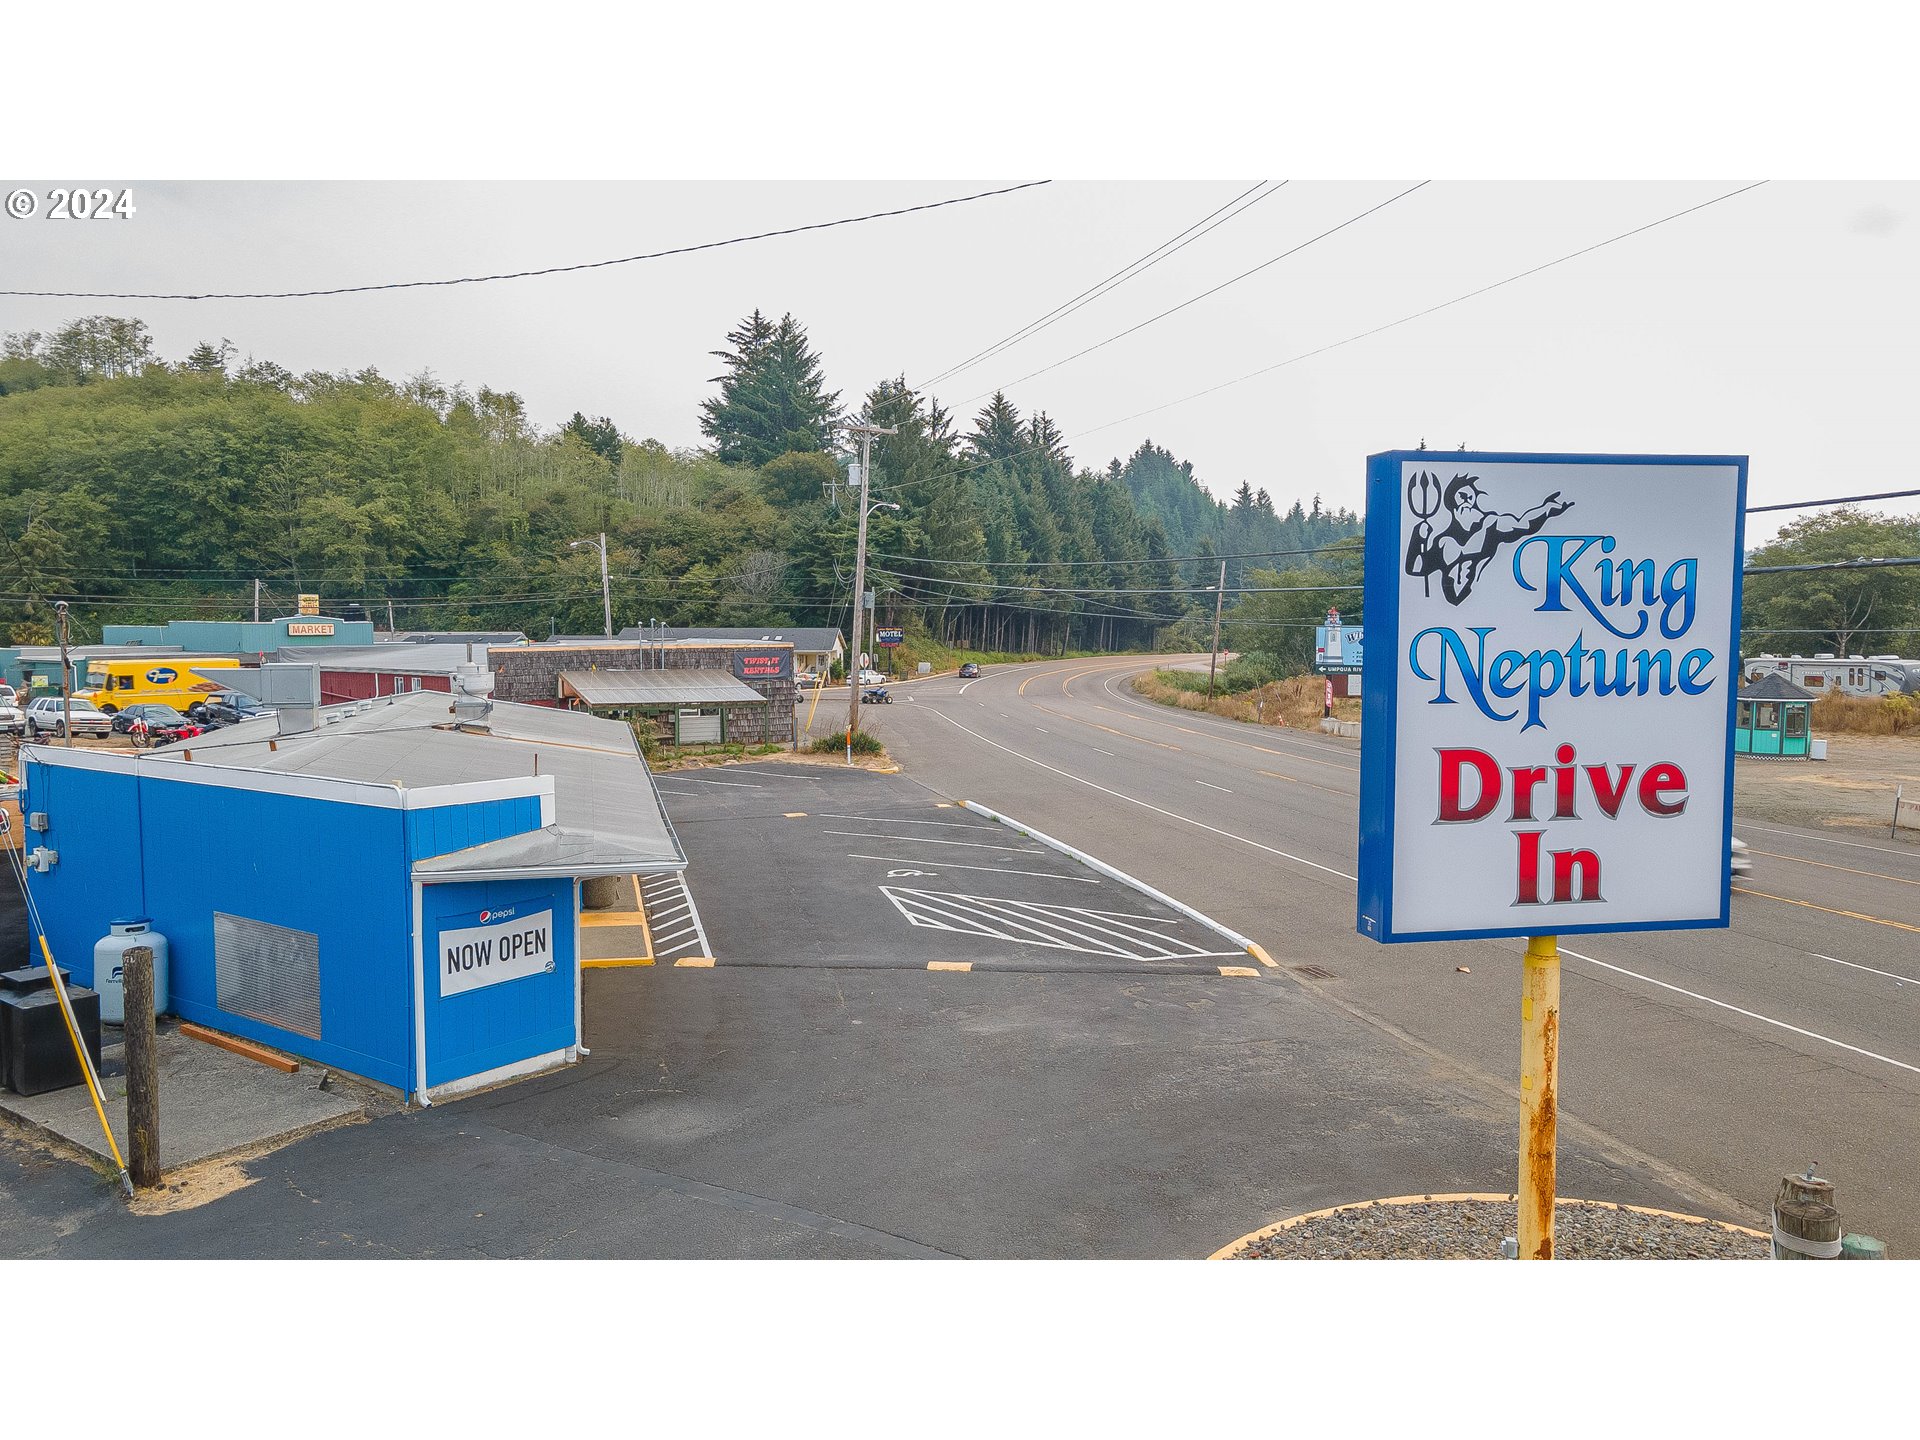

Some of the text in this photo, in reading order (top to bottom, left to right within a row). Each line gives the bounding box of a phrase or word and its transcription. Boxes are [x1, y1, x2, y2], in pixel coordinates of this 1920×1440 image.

[1512, 534, 1699, 640] King
[292, 625, 333, 634] MARKET
[879, 630, 903, 638] MOTEL
[743, 666, 780, 674] RENTALS
[744, 657, 769, 665] TWIST
[1409, 626, 1717, 734] Neptune
[1431, 742, 1691, 826] Drive
[1509, 829, 1608, 908] In
[492, 907, 515, 921] pepsi
[447, 927, 546, 975] NOW OPEN
